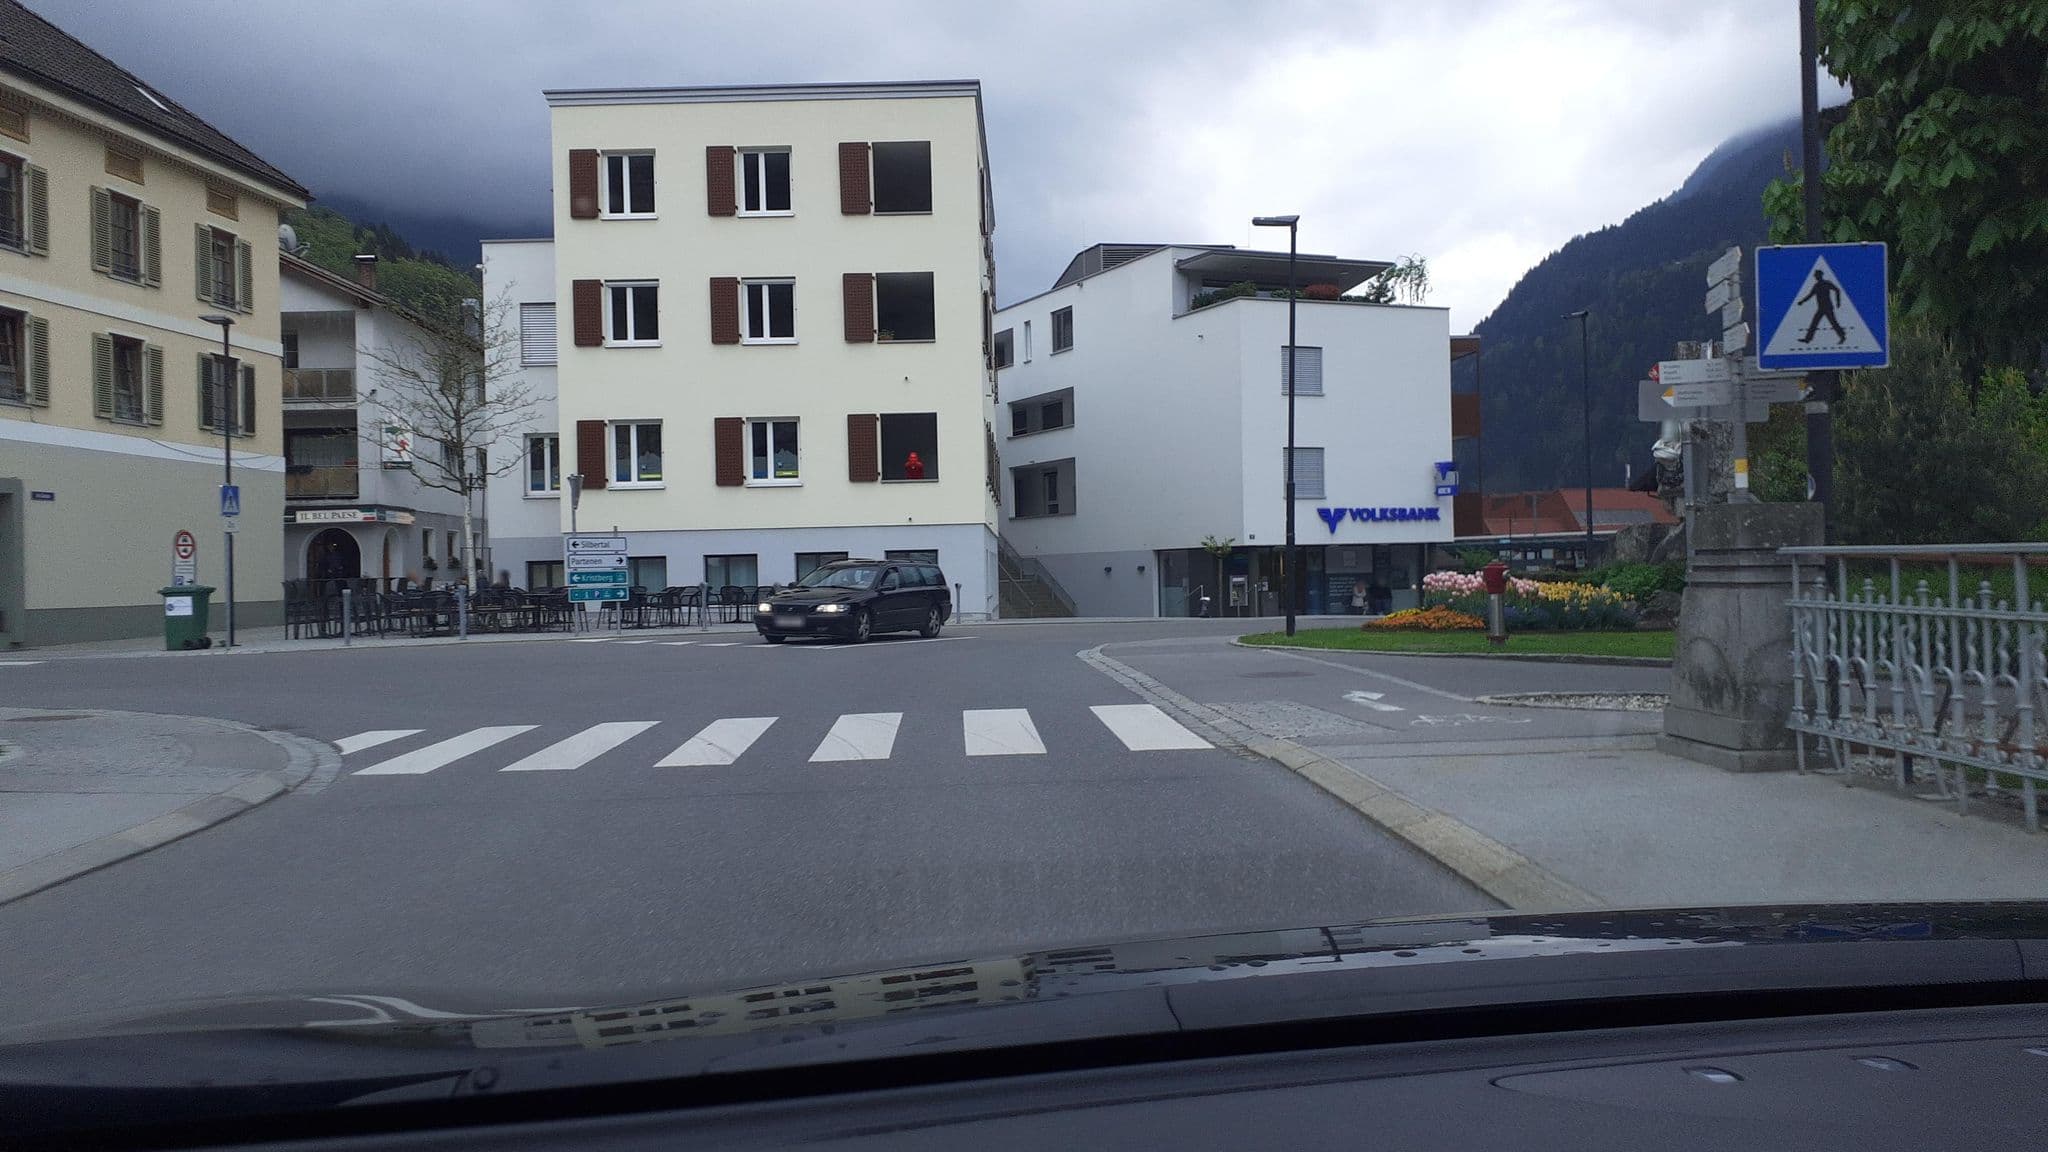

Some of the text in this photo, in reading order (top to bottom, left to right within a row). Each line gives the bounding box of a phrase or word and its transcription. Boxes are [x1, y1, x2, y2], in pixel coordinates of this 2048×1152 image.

[312, 512, 328, 520] BEL
[331, 511, 358, 519] PAESE
[1349, 507, 1440, 521] VOLKSBANK
[581, 541, 610, 549] Silbertal
[581, 574, 613, 583] Kristberg
